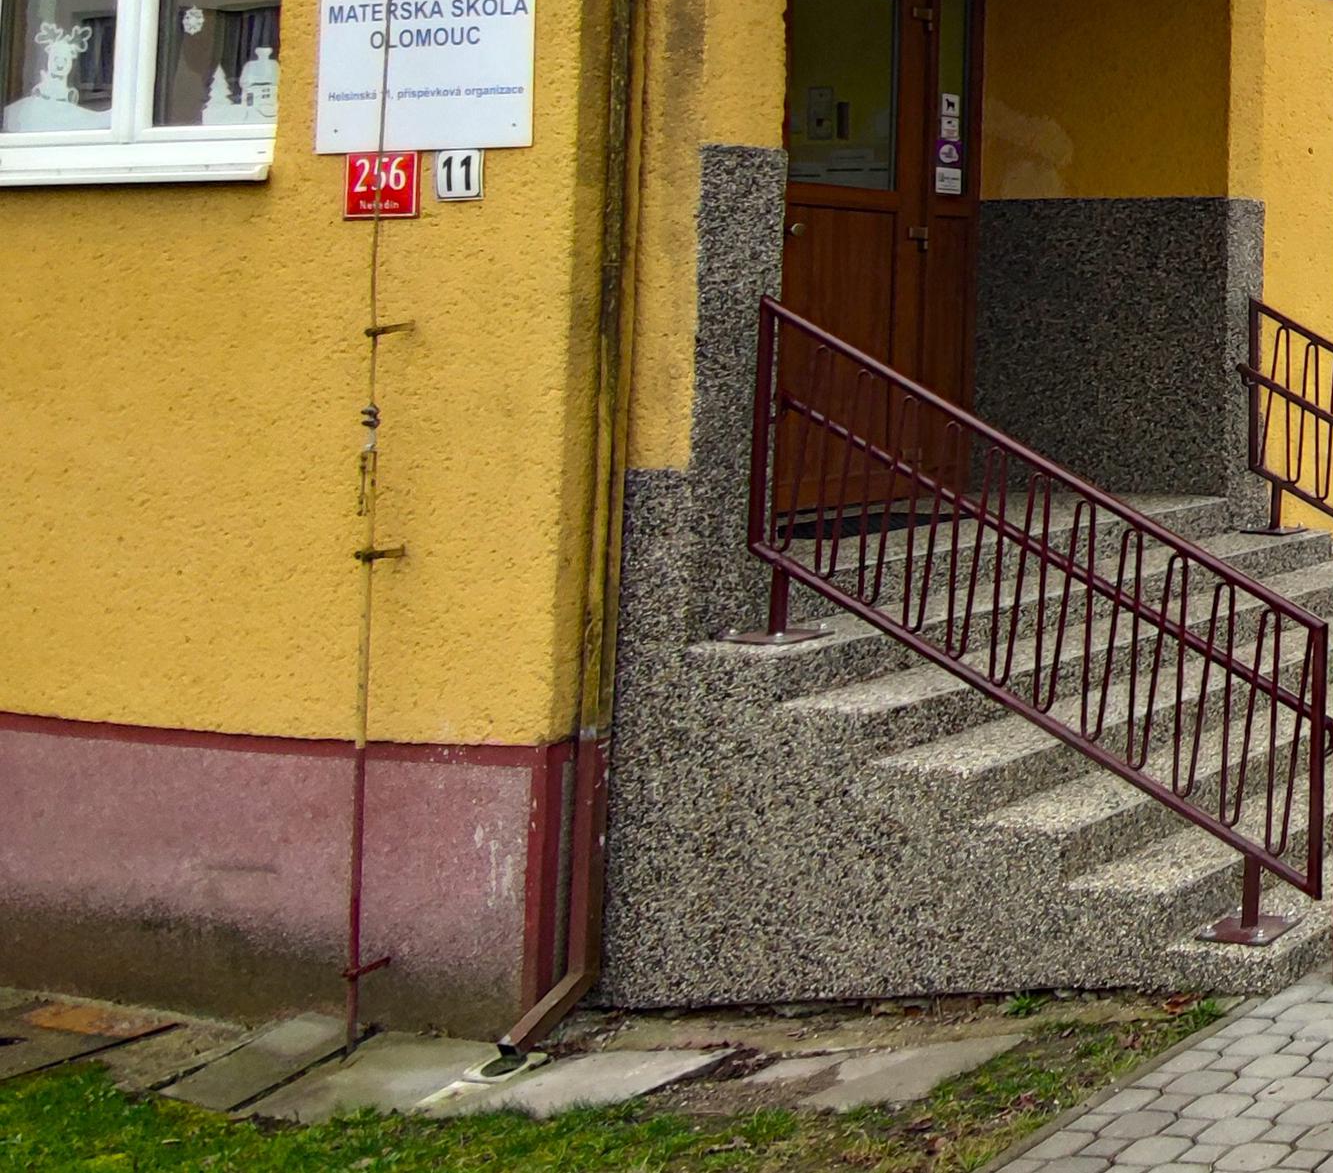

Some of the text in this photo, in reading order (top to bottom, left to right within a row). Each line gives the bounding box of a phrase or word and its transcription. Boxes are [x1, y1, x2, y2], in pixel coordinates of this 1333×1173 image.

[370, 26, 481, 50] OLOMOUC
[328, 89, 377, 102] Helsinská
[397, 85, 462, 101] příspěvková
[464, 84, 525, 99] organizace
[353, 157, 407, 193] 256
[442, 155, 472, 192] 11
